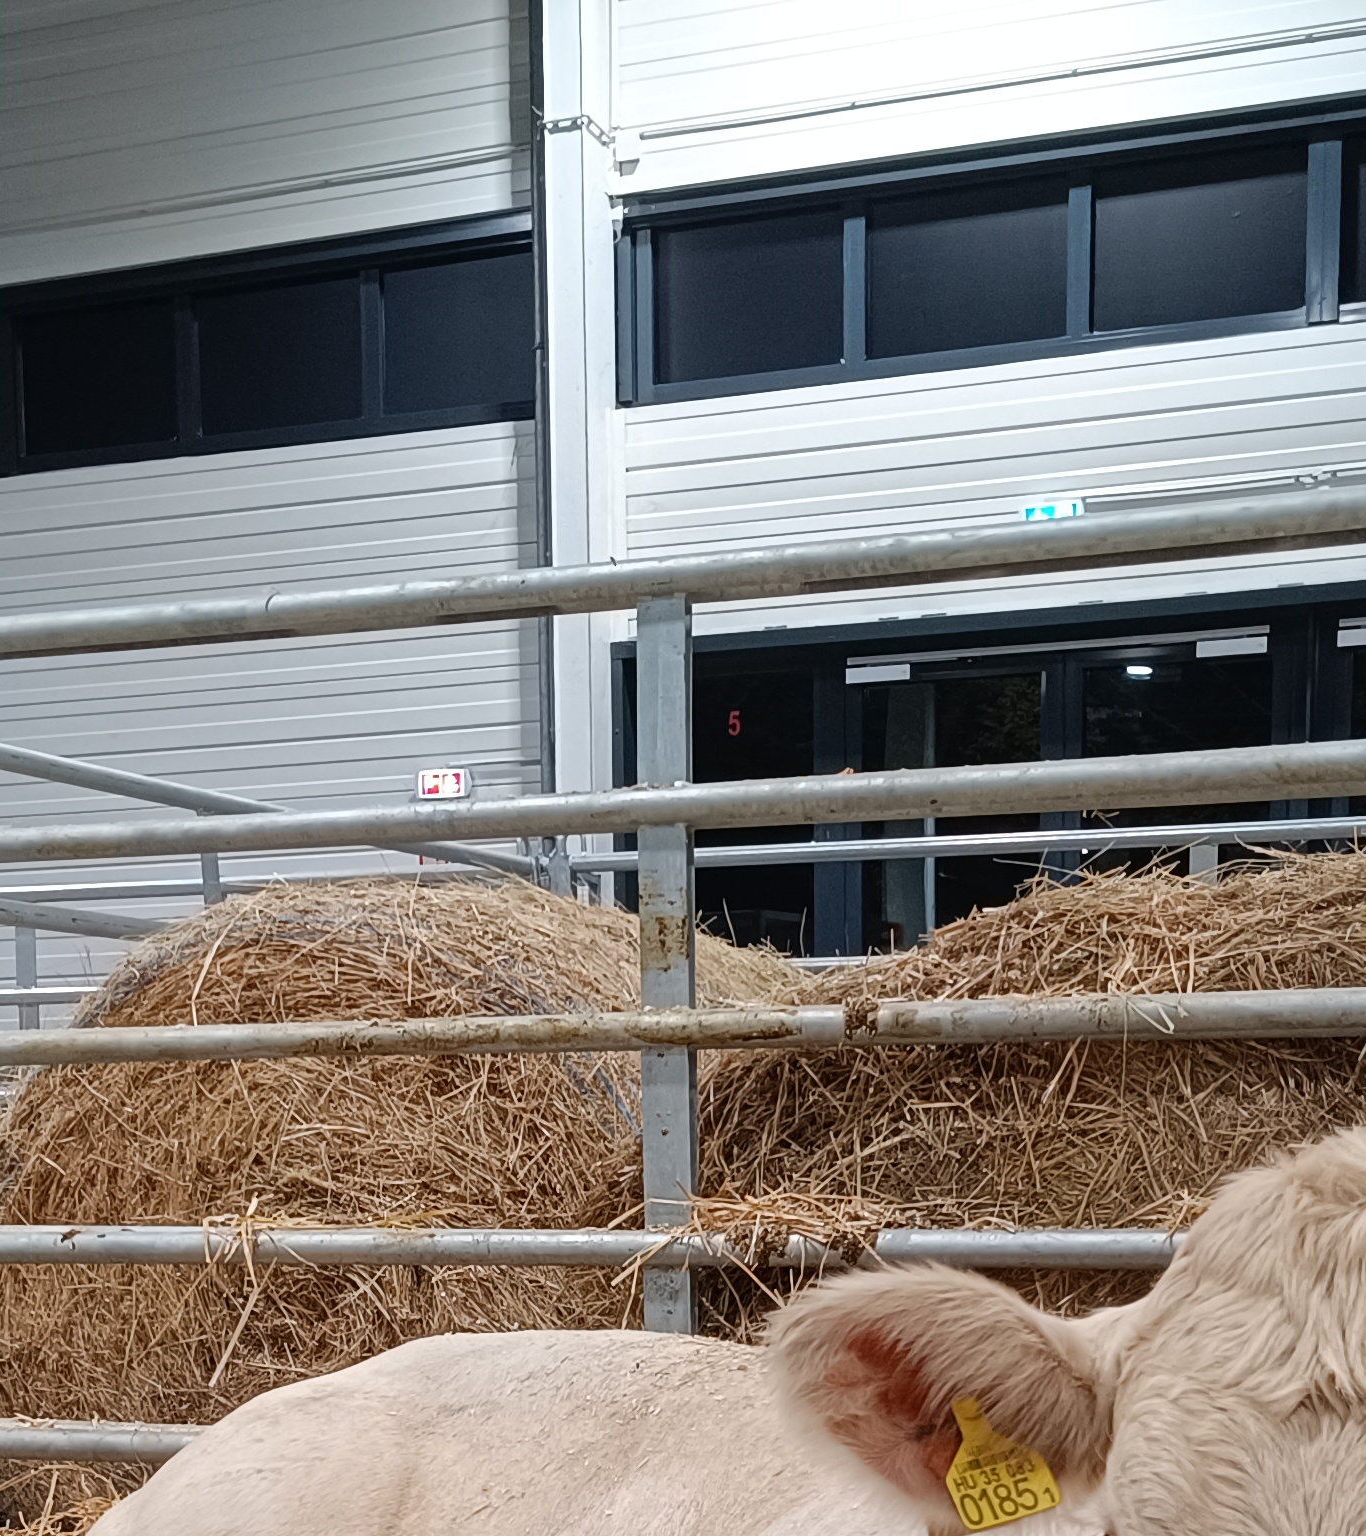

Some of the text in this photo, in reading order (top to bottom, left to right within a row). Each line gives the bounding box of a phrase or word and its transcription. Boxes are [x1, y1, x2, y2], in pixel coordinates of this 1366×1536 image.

[728, 710, 741, 736] 5
[953, 1458, 1035, 1493] HU 35 083
[959, 1477, 1055, 1526] 0185 1
